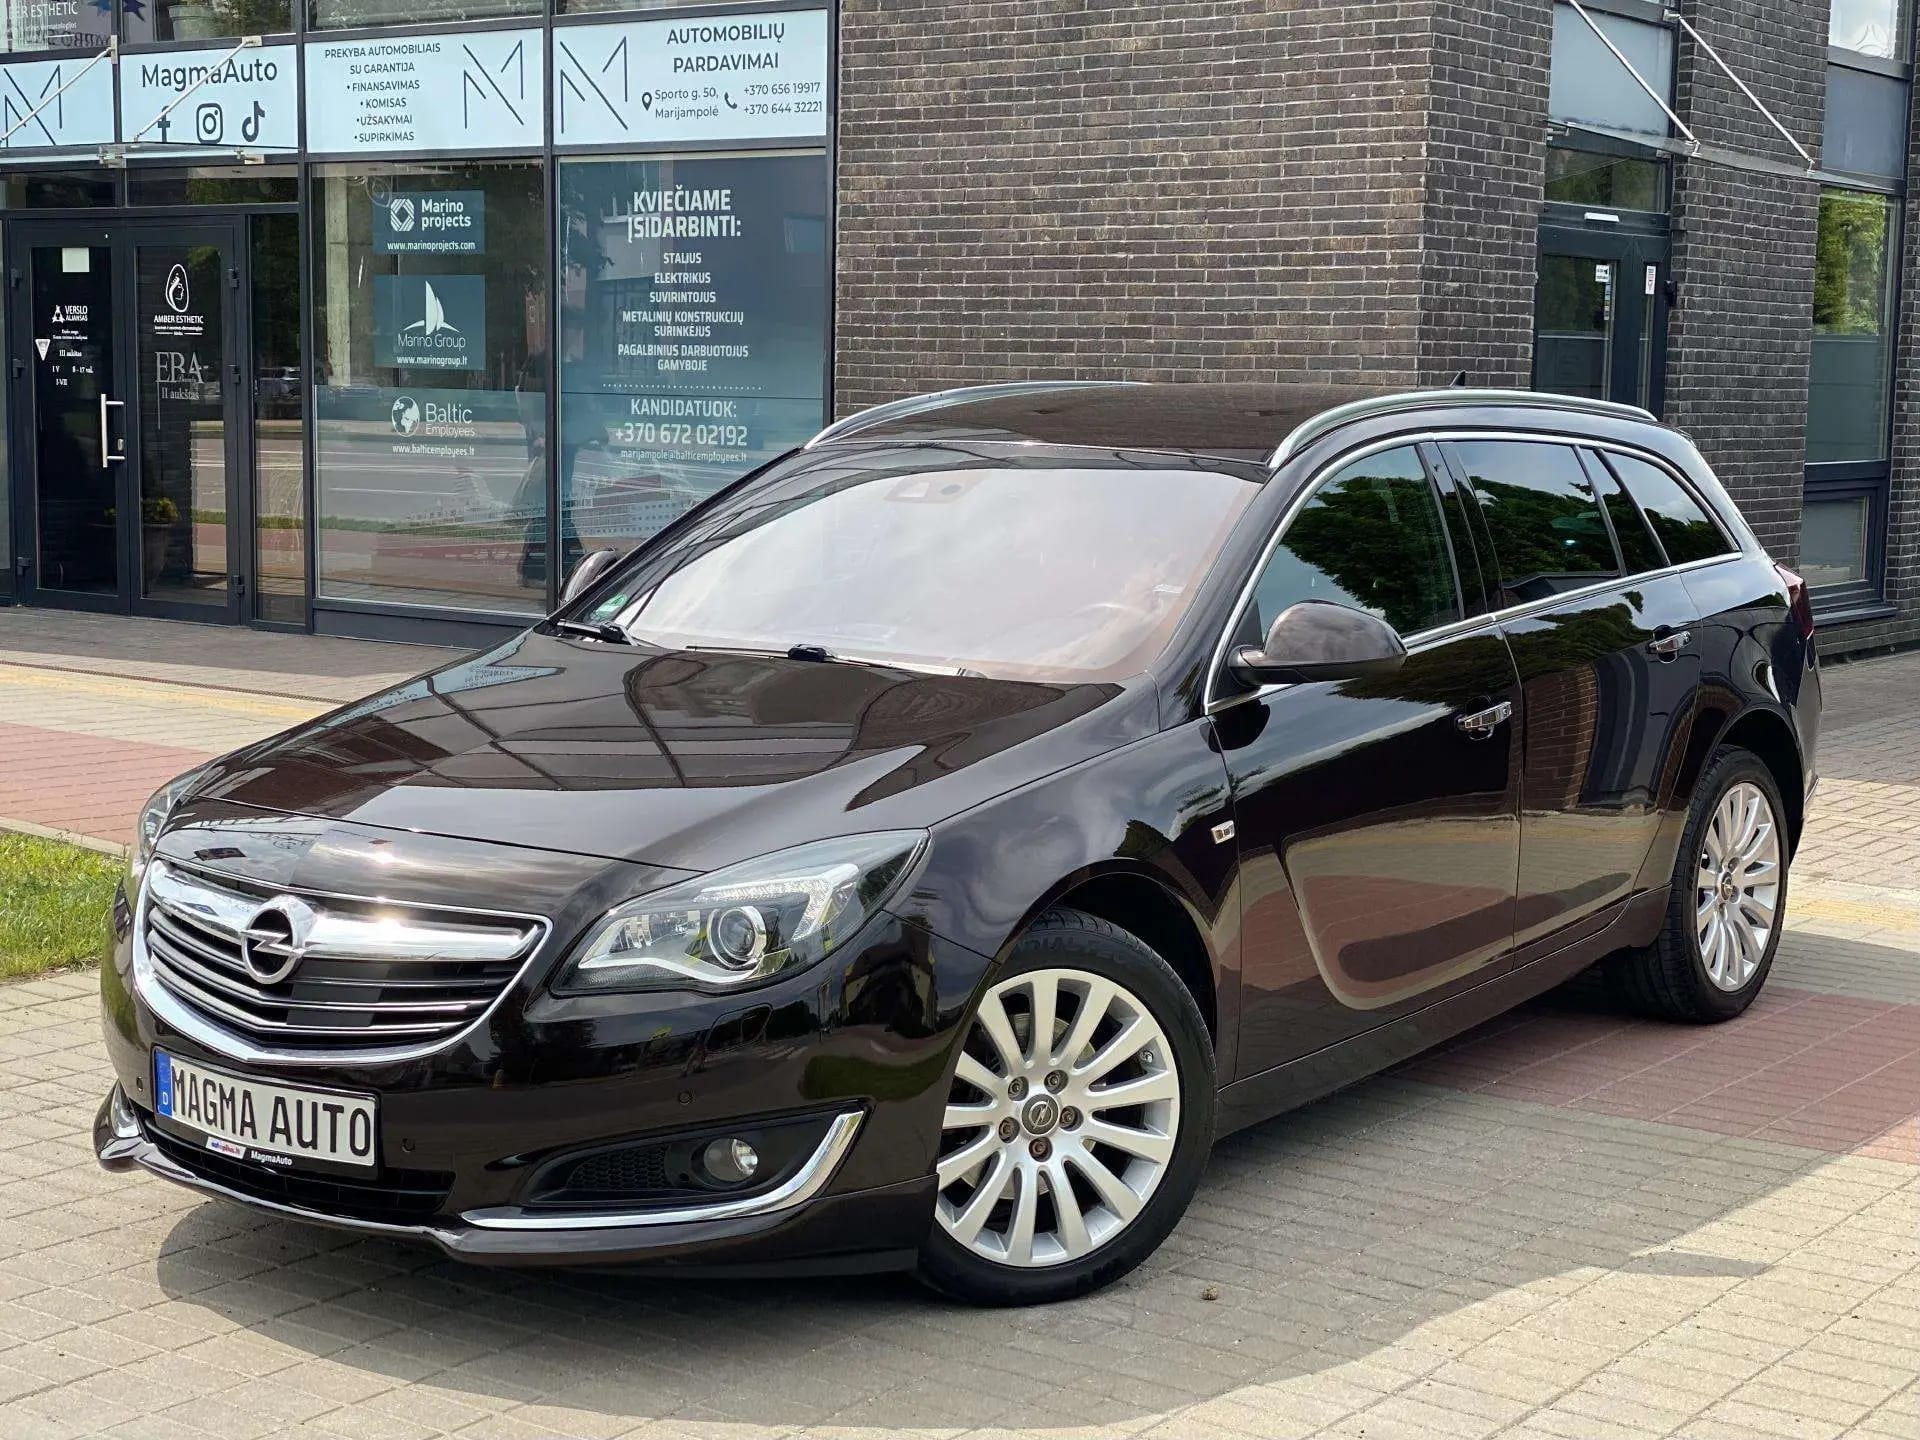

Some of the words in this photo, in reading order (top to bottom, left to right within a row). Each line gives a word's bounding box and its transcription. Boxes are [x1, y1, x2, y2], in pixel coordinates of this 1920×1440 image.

[666, 22, 785, 45] AUTOMOBILIŲ
[324, 47, 366, 59] PREKYBA
[368, 42, 441, 57] AUTOMOBILIAIS
[350, 64, 362, 75] SU
[364, 62, 416, 74] GARANTIJA
[673, 52, 779, 73] PARDAVIMAI
[141, 58, 278, 92] MagmaAuto
[352, 80, 421, 92] FINANSAVIMAS
[743, 84, 769, 95] +370
[771, 83, 791, 94] 656
[793, 81, 821, 94] 19917
[655, 88, 689, 102] Sporto
[691, 90, 699, 101] g.
[703, 87, 719, 99] 50,
[365, 97, 407, 109] KOMISAS
[743, 103, 769, 115] +370
[771, 102, 792, 114] 644
[794, 101, 823, 113] 32221
[655, 105, 719, 120] Marijampolė
[360, 114, 413, 126] UŽSAKYMAI
[359, 131, 415, 143] SUPIRKIMAS
[633, 184, 731, 212] KVIEČIAME
[421, 198, 464, 213] Marino
[421, 212, 472, 231] projects
[628, 215, 742, 243] ĮSIDARBINTI:
[387, 240, 476, 252] www.marinoprojects.com
[663, 252, 702, 264] STALIUS
[654, 272, 711, 284] ELEKTRIKUS
[649, 291, 717, 303] SUVIRINTOJUS
[65, 305, 88, 315] VERSLO
[154, 315, 175, 323] AMBER
[176, 315, 204, 324] ESTHETIC
[622, 310, 672, 325] METALINIŲ
[674, 311, 744, 325] KONSTRUKCIJŲ
[654, 324, 711, 337] SURINKĖJUS
[397, 333, 432, 348] Marino
[434, 333, 466, 351] Group
[618, 344, 679, 356] PAGALBINIUS
[681, 345, 749, 357] DARBUOTOJUS
[396, 355, 468, 367] www.marinogroup.lt
[657, 359, 708, 371] GAMYBOJE
[425, 403, 473, 424] Baltic
[631, 399, 737, 418] KANDIDATUOK:
[425, 424, 476, 438] Employees
[615, 422, 655, 443] +370
[660, 424, 691, 444] 672
[696, 425, 748, 446] 02192
[392, 444, 475, 458] www.balticemployees.lt
[171, 1065, 258, 1140] MAGMA
[269, 1096, 371, 1158] AUTO
[250, 1150, 293, 1166] MagmaAuto
